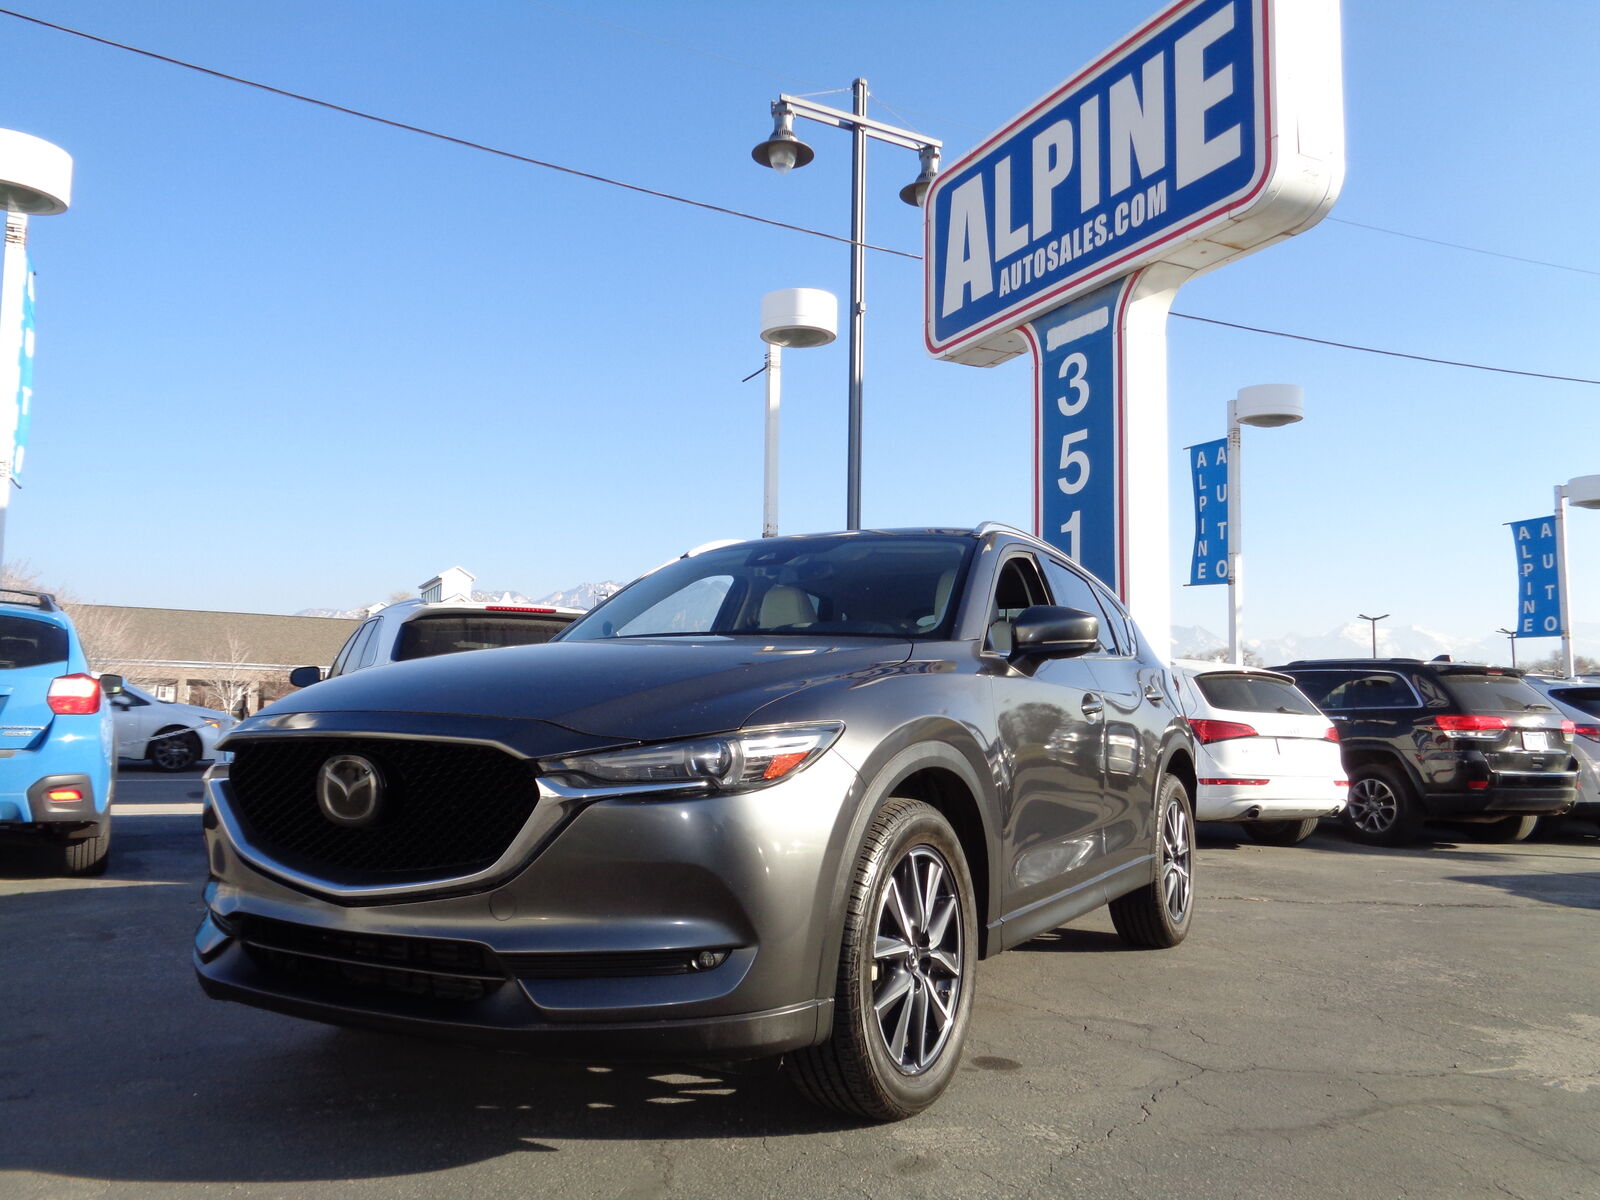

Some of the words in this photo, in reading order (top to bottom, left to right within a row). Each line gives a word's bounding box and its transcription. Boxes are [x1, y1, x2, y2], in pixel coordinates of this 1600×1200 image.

[942, 1, 1241, 318] ALPINE
[998, 179, 1167, 298] AUTOSALES.COM
[1196, 451, 1208, 579] ALPINE
[1216, 446, 1229, 578] AUTO
[1518, 525, 1536, 632] ALPINE
[1540, 522, 1558, 632] AUTO
